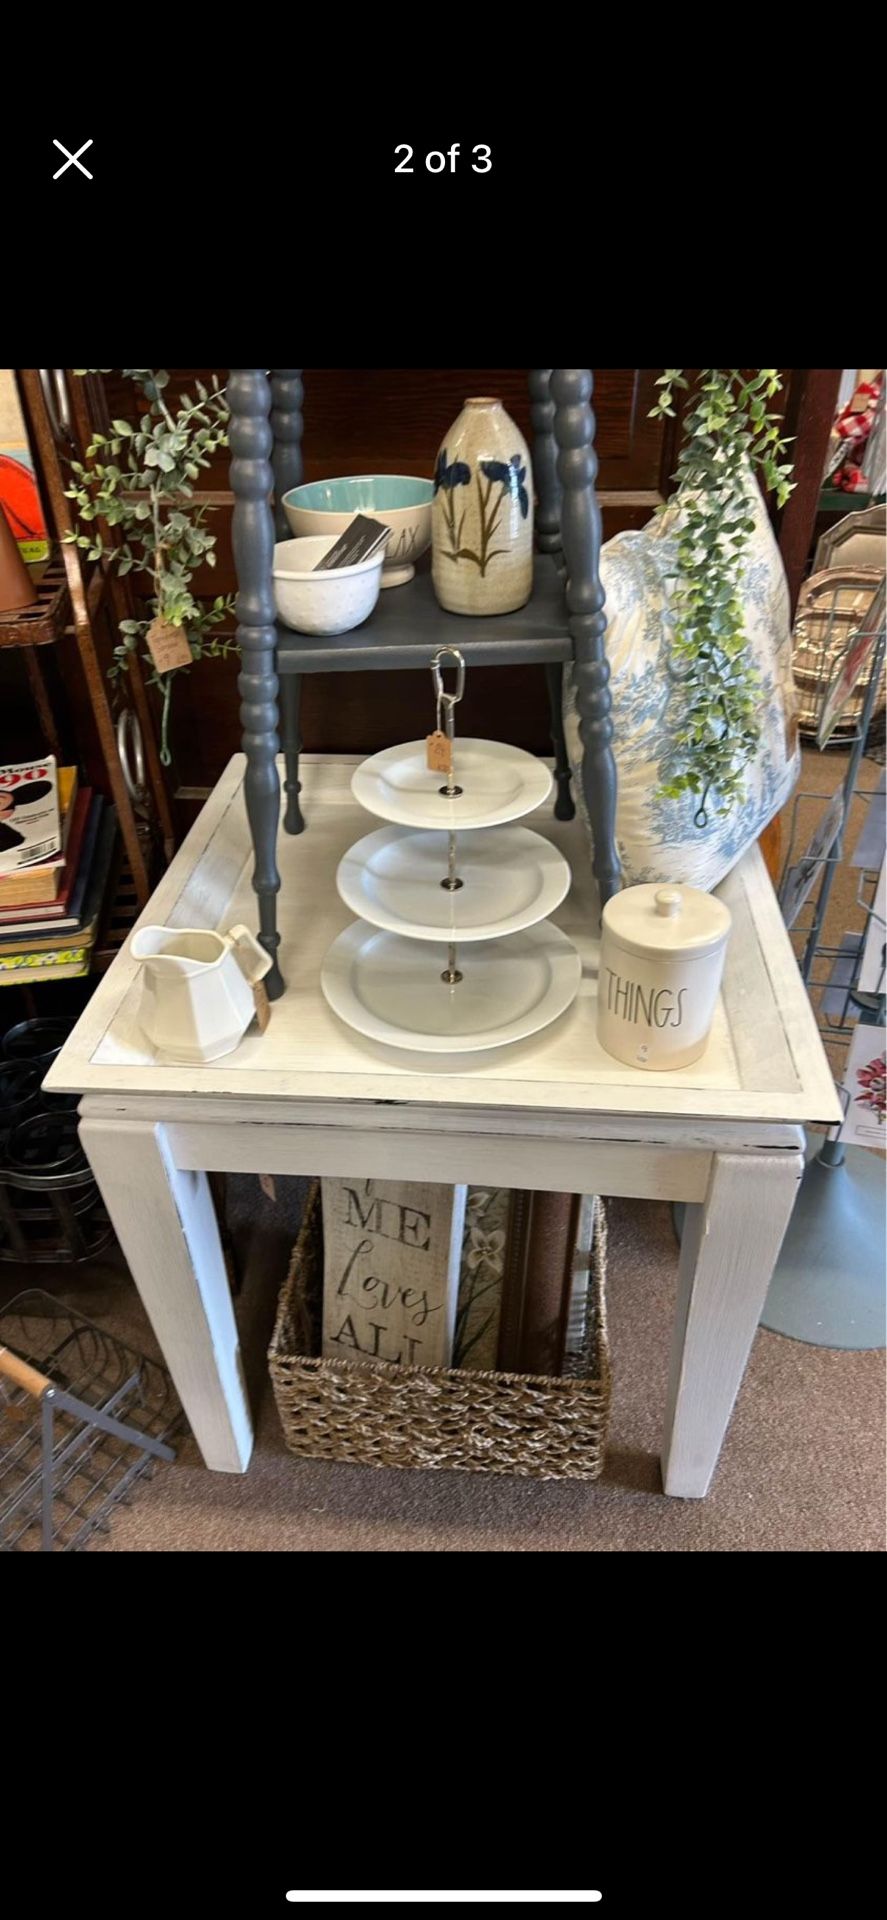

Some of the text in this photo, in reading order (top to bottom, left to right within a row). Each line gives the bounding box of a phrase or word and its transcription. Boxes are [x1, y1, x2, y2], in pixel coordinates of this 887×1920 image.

[605, 967, 688, 1028] THINGS
[341, 1186, 431, 1252] ME
[337, 1239, 444, 1326] Loves
